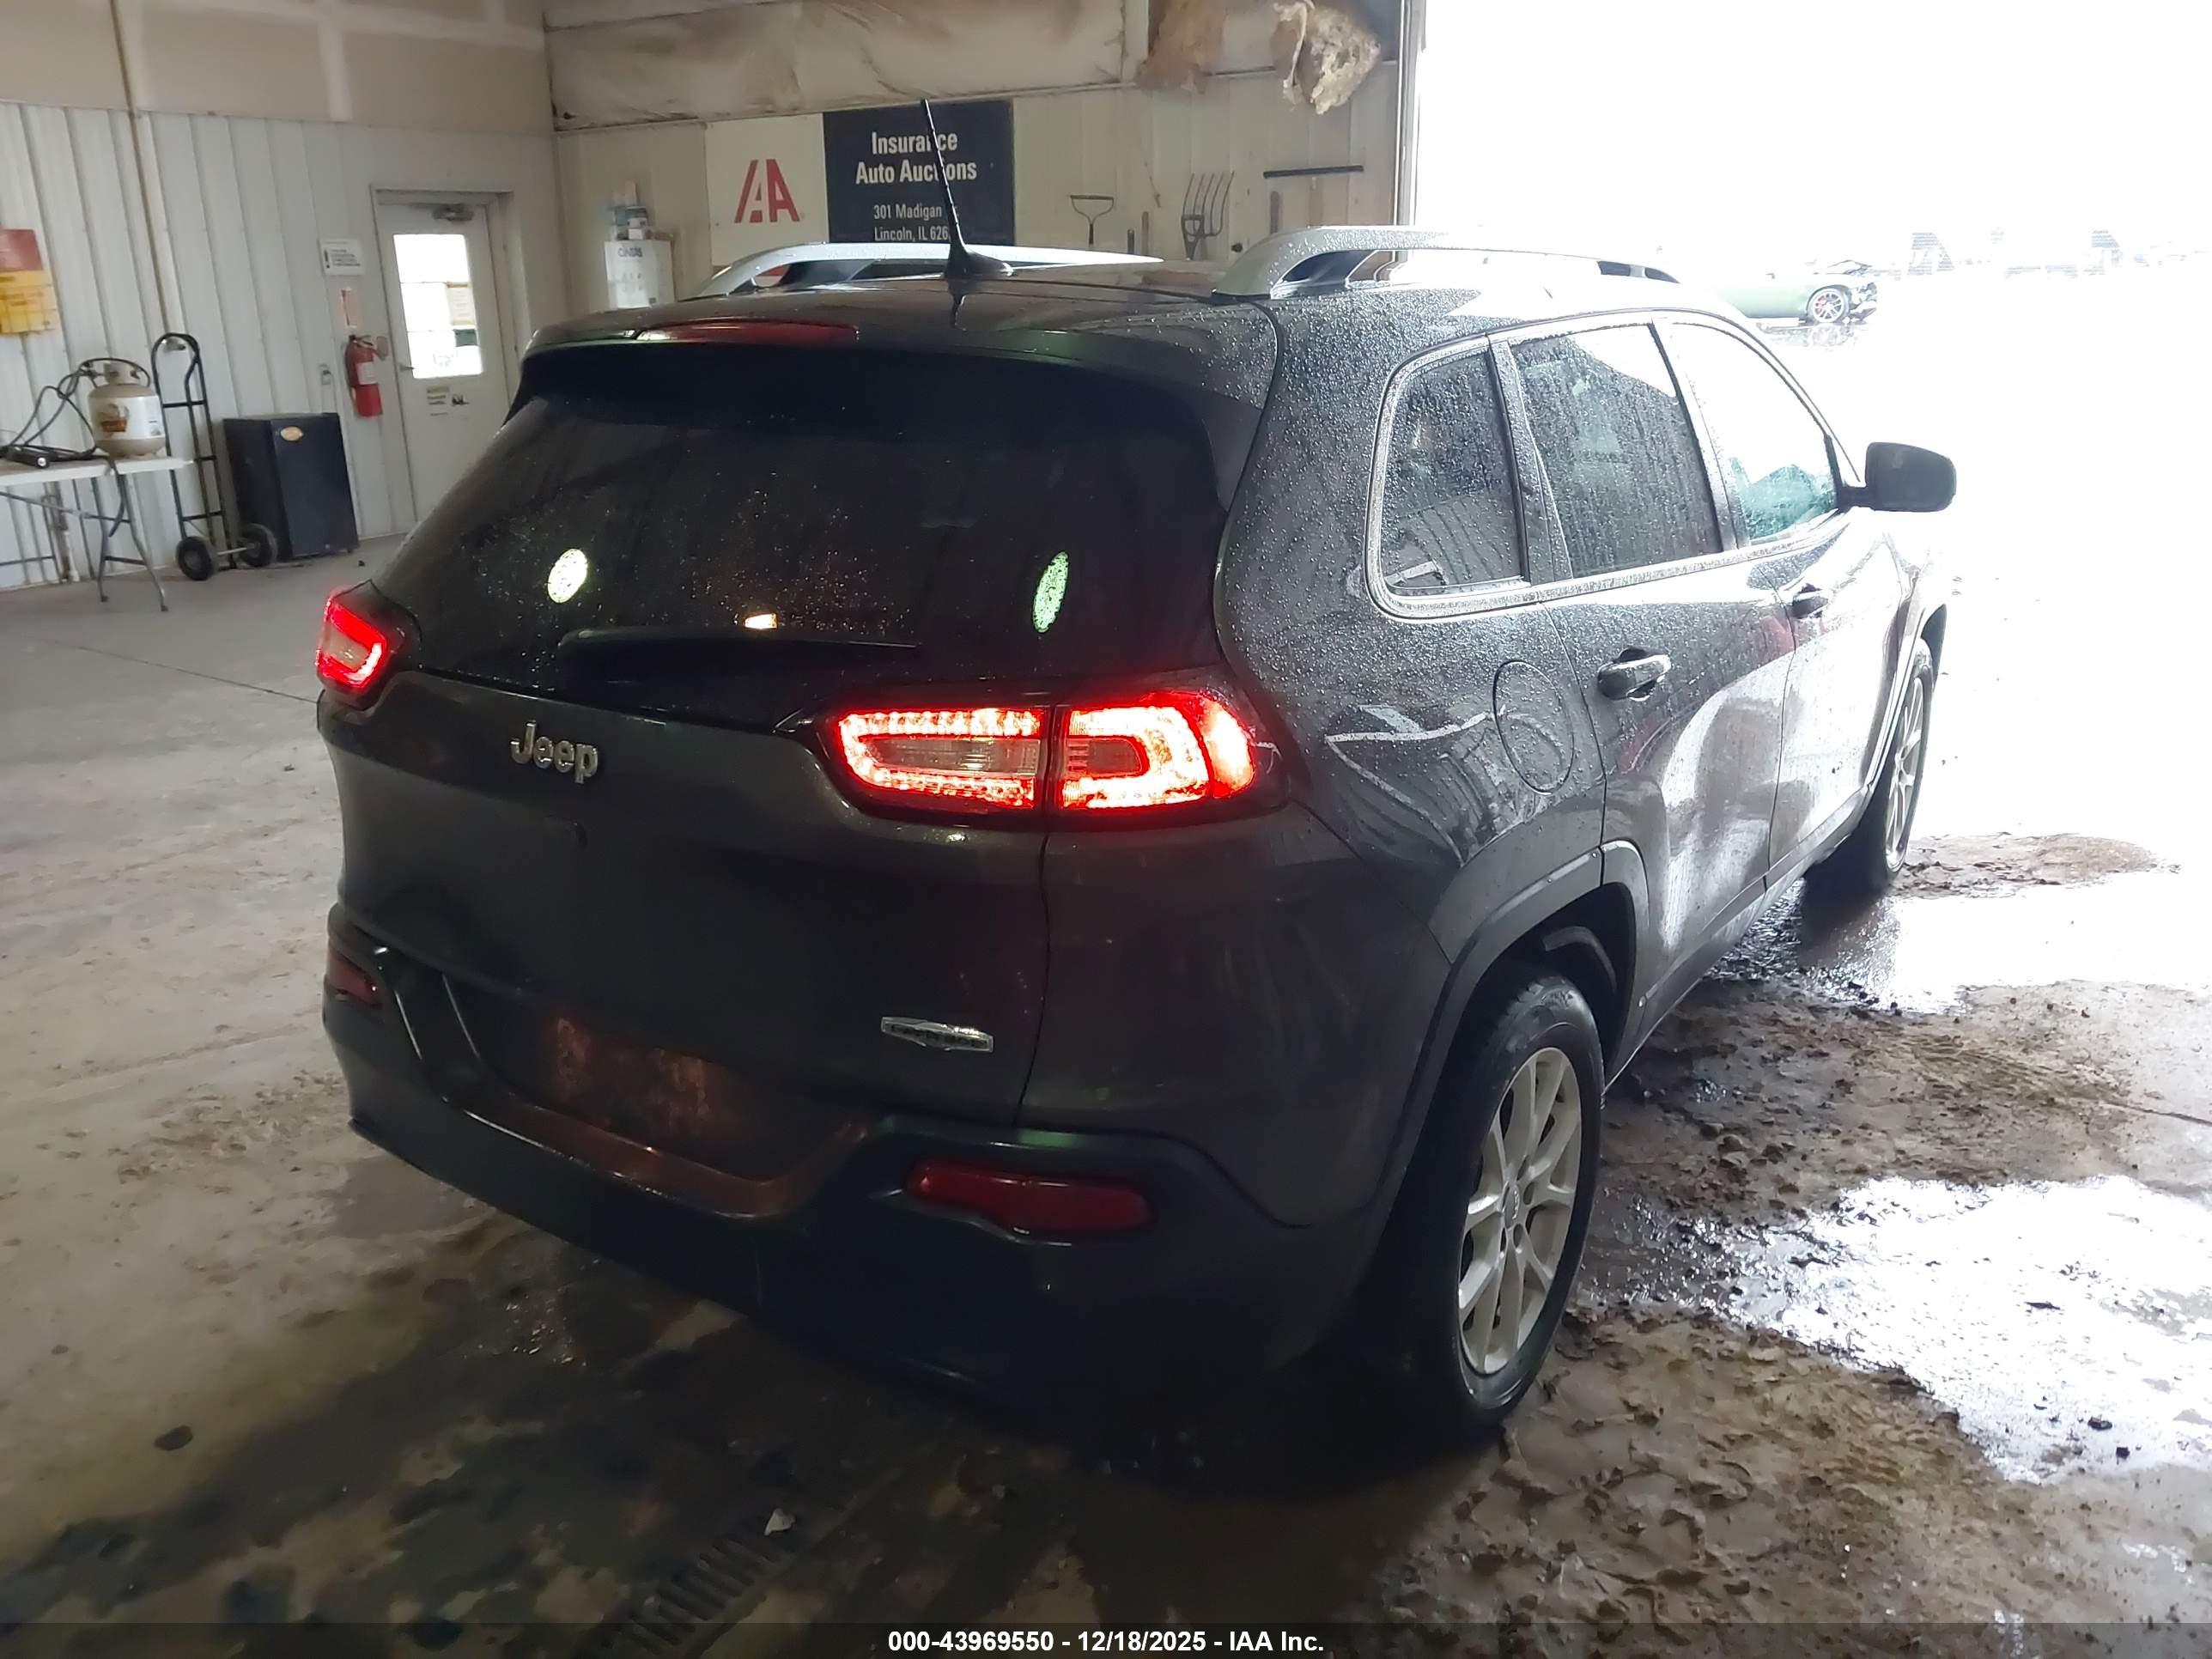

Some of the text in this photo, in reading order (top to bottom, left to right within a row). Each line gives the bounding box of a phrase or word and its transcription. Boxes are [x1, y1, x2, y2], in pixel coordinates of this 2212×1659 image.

[855, 158, 977, 185] Auto Aucons
[873, 204, 891, 220] 301
[895, 203, 942, 221] Madigan
[874, 225, 951, 242] Lincoln, IL 626
[510, 720, 599, 784] Jeep
